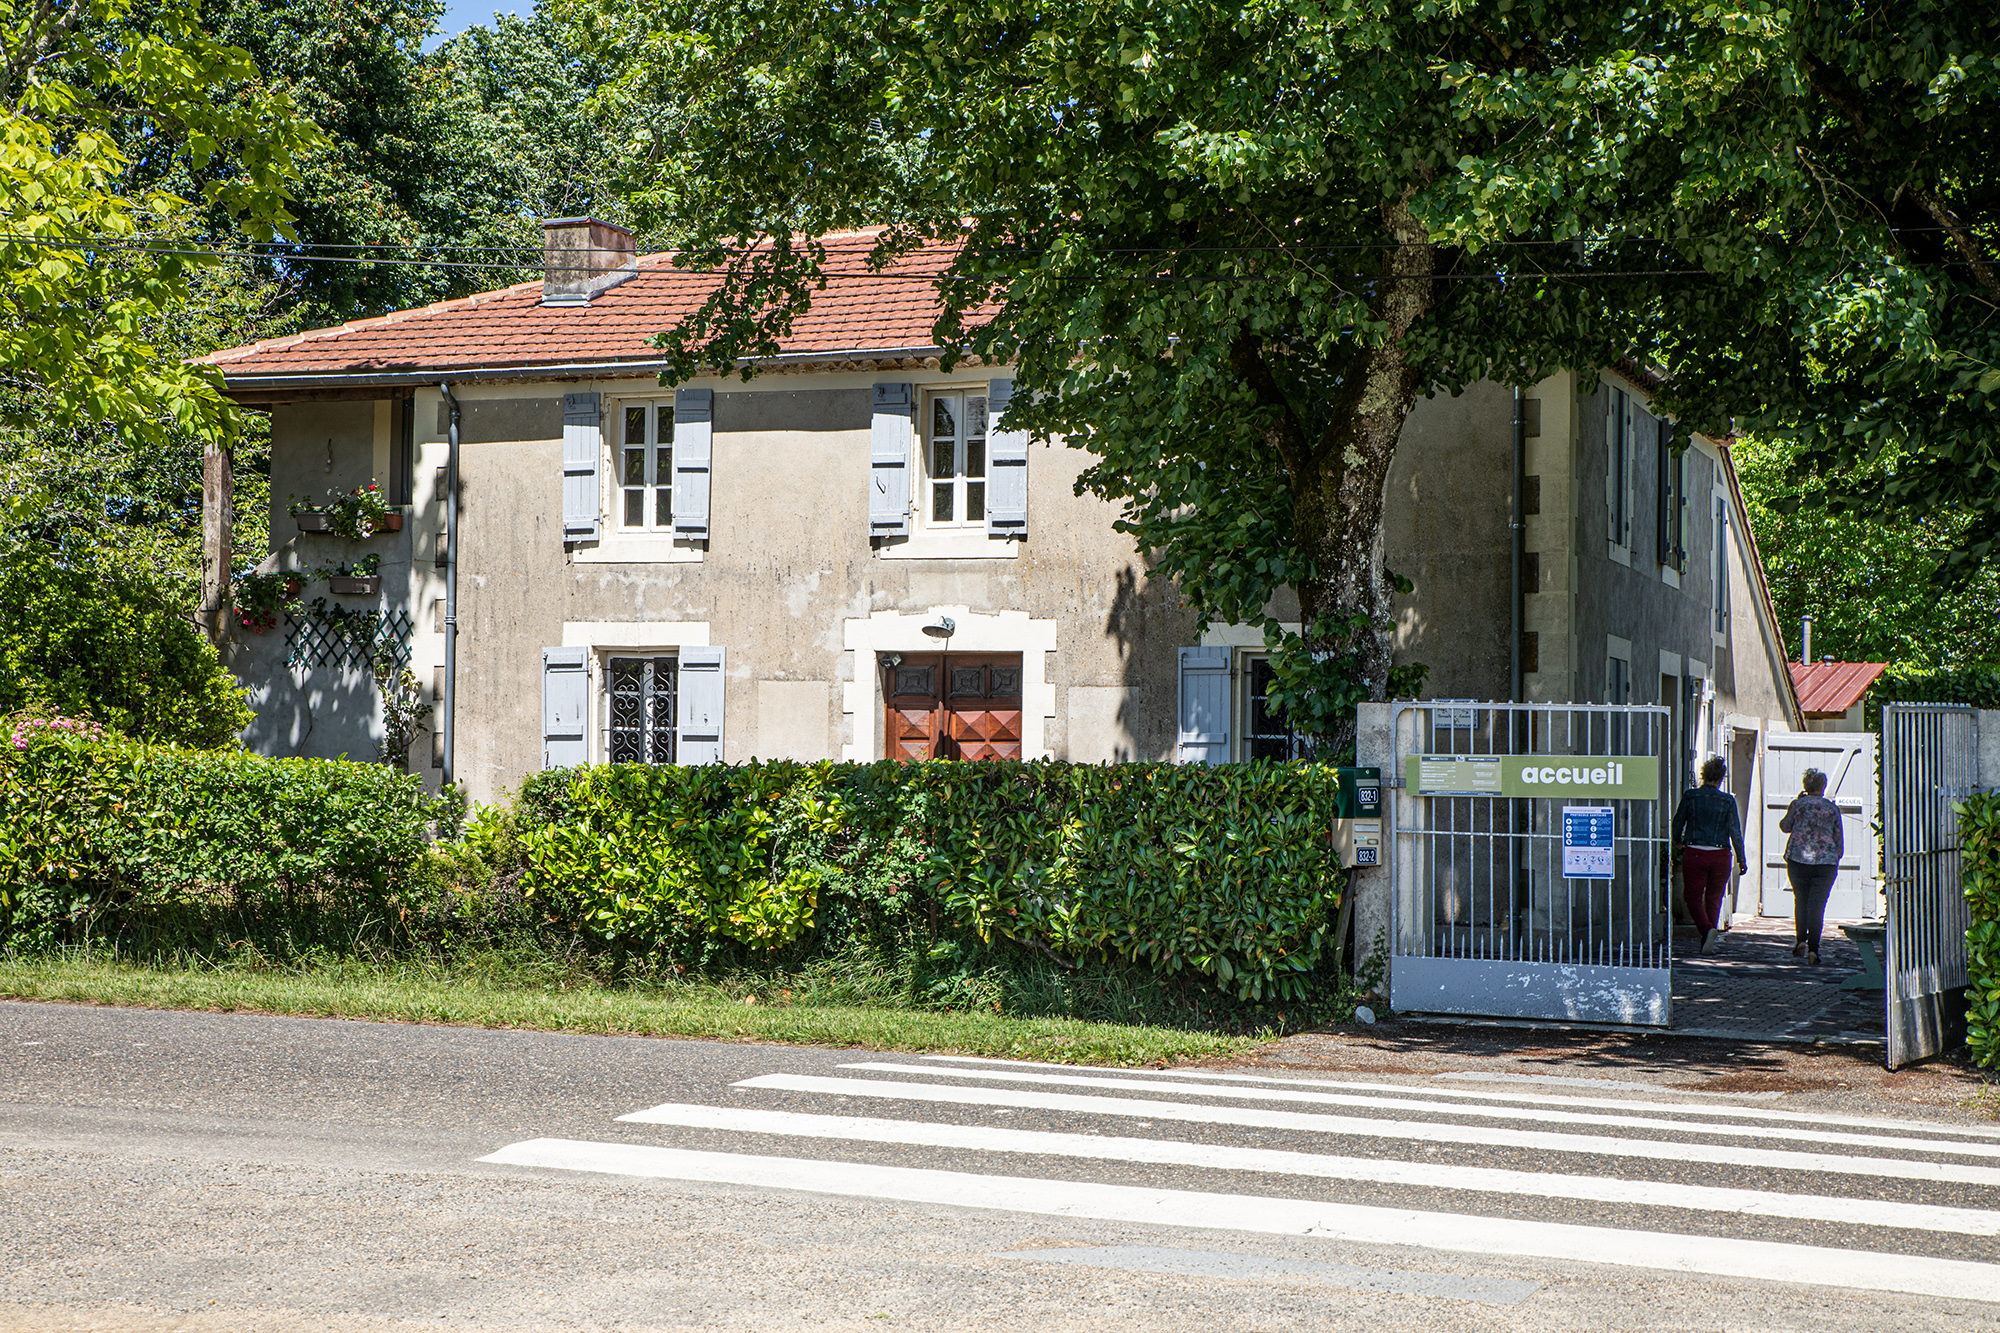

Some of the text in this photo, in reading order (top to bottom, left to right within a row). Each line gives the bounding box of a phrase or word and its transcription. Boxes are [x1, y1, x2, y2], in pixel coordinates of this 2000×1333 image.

[1521, 761, 1623, 785] accueil
[1360, 790, 1376, 802] 832-1
[1358, 850, 1375, 862] 832-2
